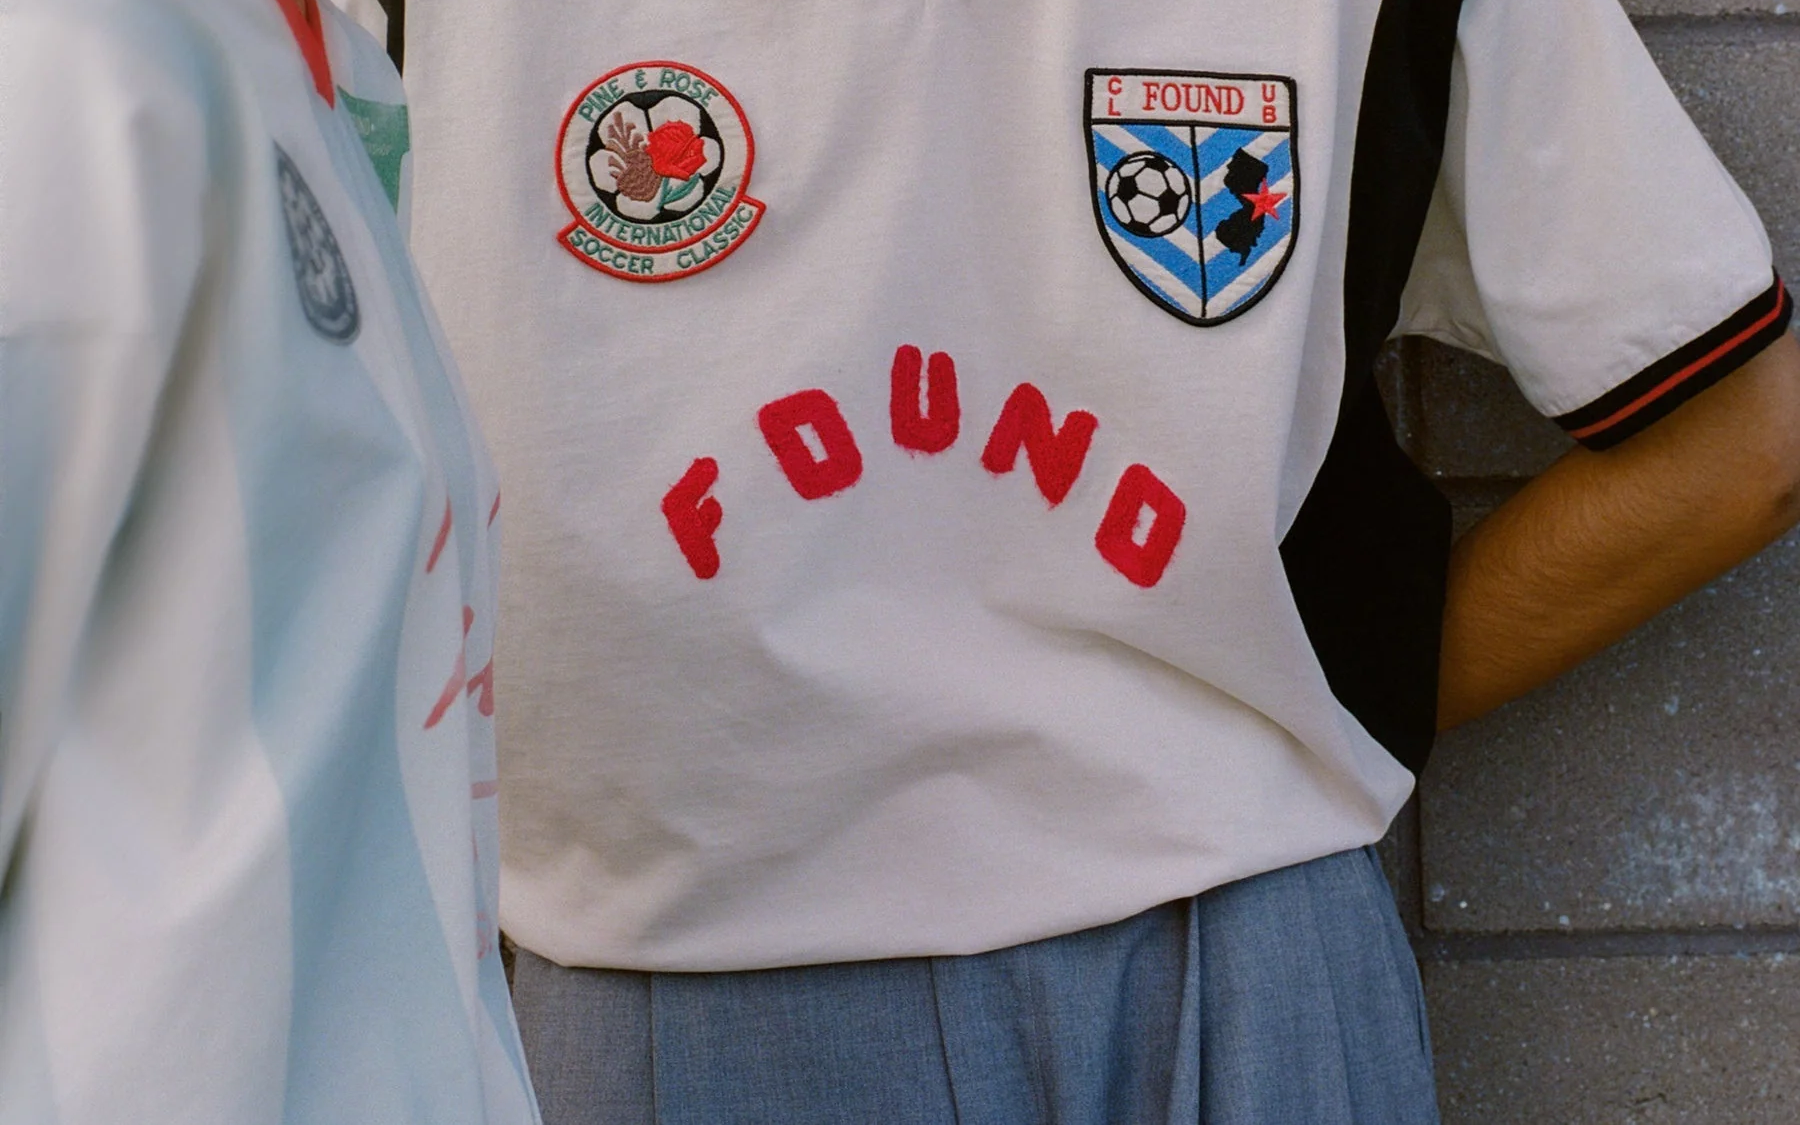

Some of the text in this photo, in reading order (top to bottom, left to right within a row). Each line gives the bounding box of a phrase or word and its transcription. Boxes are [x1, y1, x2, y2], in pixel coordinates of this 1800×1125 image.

[578, 78, 625, 123] PINE
[659, 69, 720, 107] ROSE
[1142, 82, 1245, 115] FOUND
[570, 206, 754, 274] SOCCER CLASSIC
[583, 185, 737, 246] INTERNATIONAL
[661, 344, 1187, 589] FOUND
